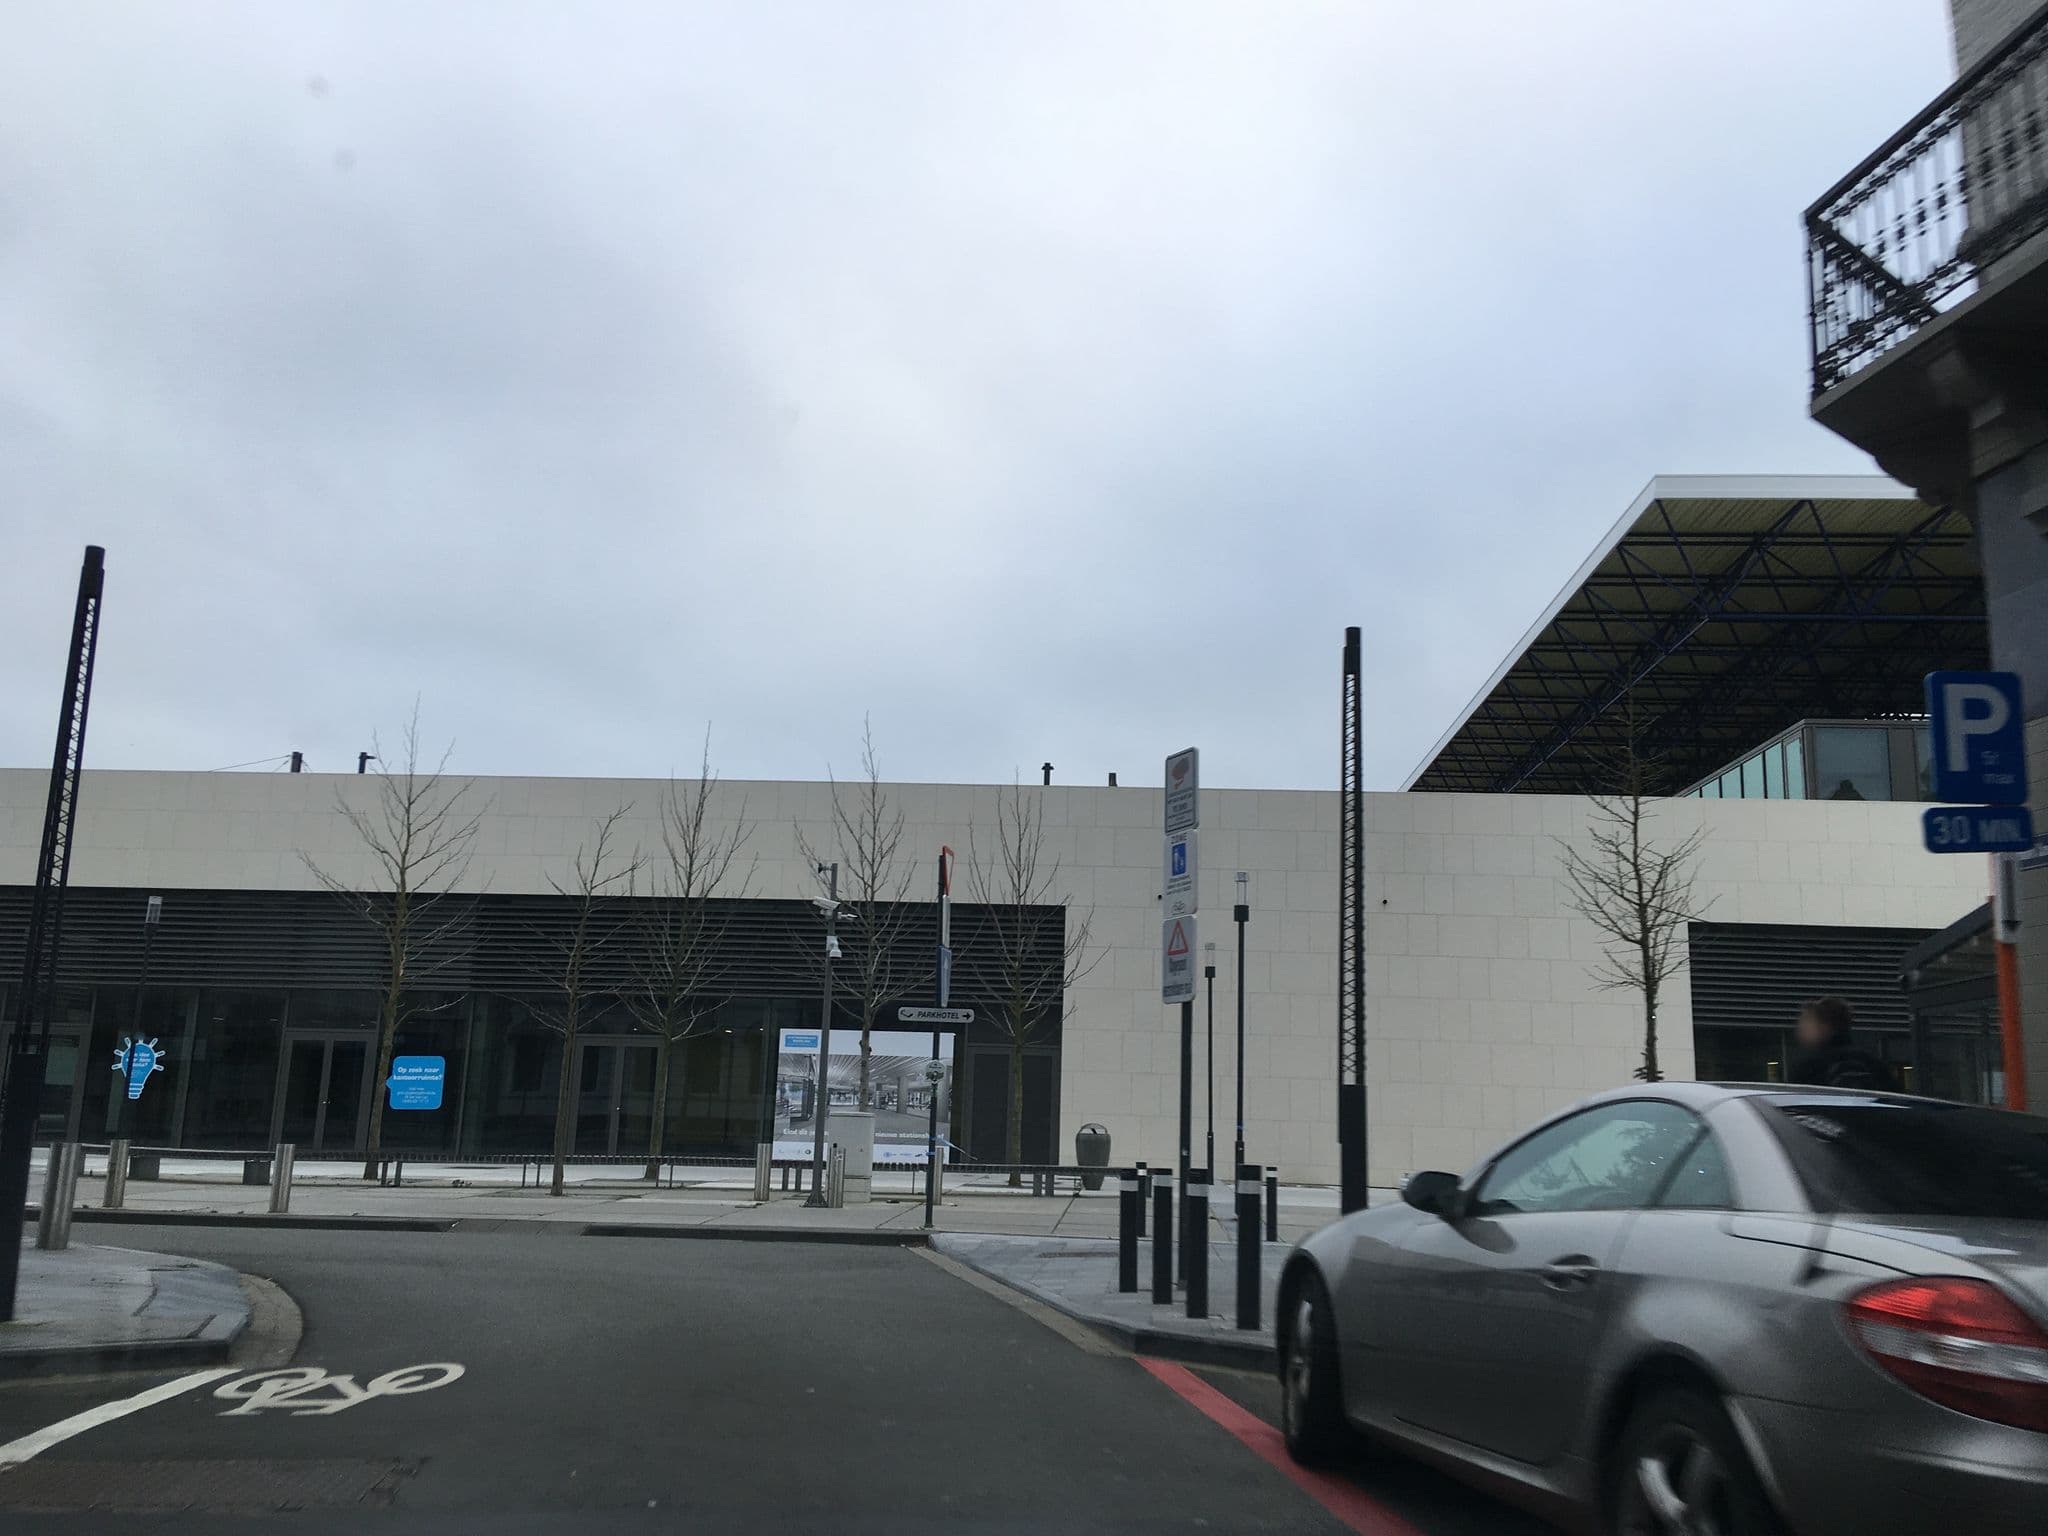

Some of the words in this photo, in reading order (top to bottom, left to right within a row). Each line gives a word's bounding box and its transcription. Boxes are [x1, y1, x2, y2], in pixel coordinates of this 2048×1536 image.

[1944, 682, 2011, 773] P
[1932, 814, 1971, 845] 30
[917, 1010, 960, 1020] PARKHOTEL
[397, 1066, 408, 1074] Op
